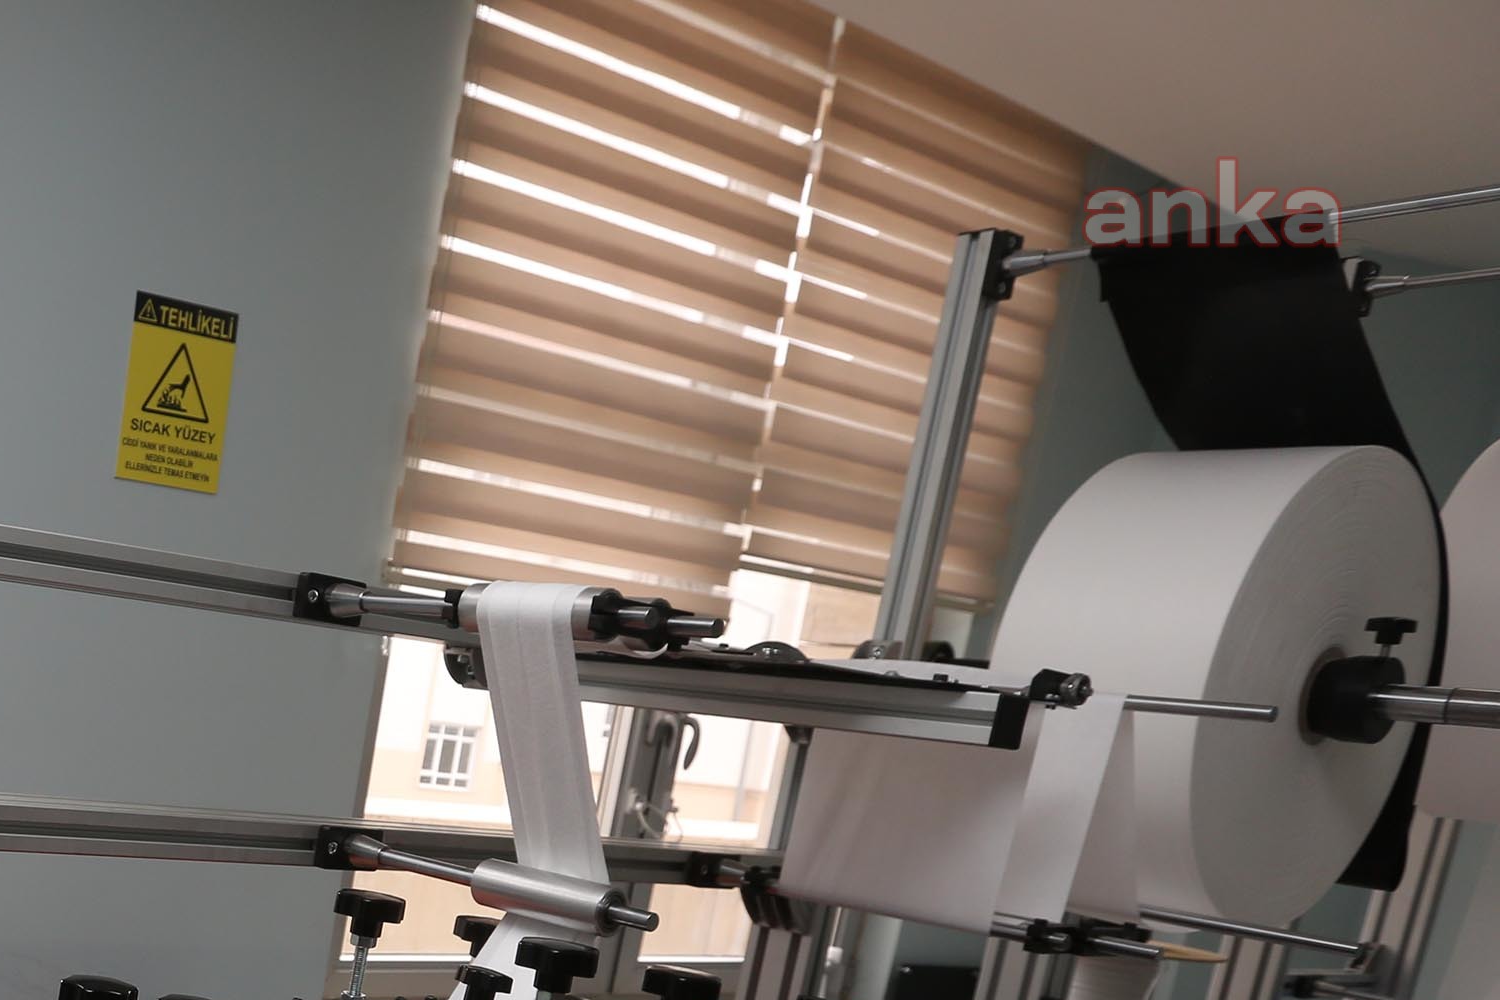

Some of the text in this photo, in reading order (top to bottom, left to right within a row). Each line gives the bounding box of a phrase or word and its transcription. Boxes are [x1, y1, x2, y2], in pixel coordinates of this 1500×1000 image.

[160, 305, 234, 339] TEHLİKELİ
[130, 418, 216, 444] SICAK YÜZEY
[158, 443, 167, 452] VE
